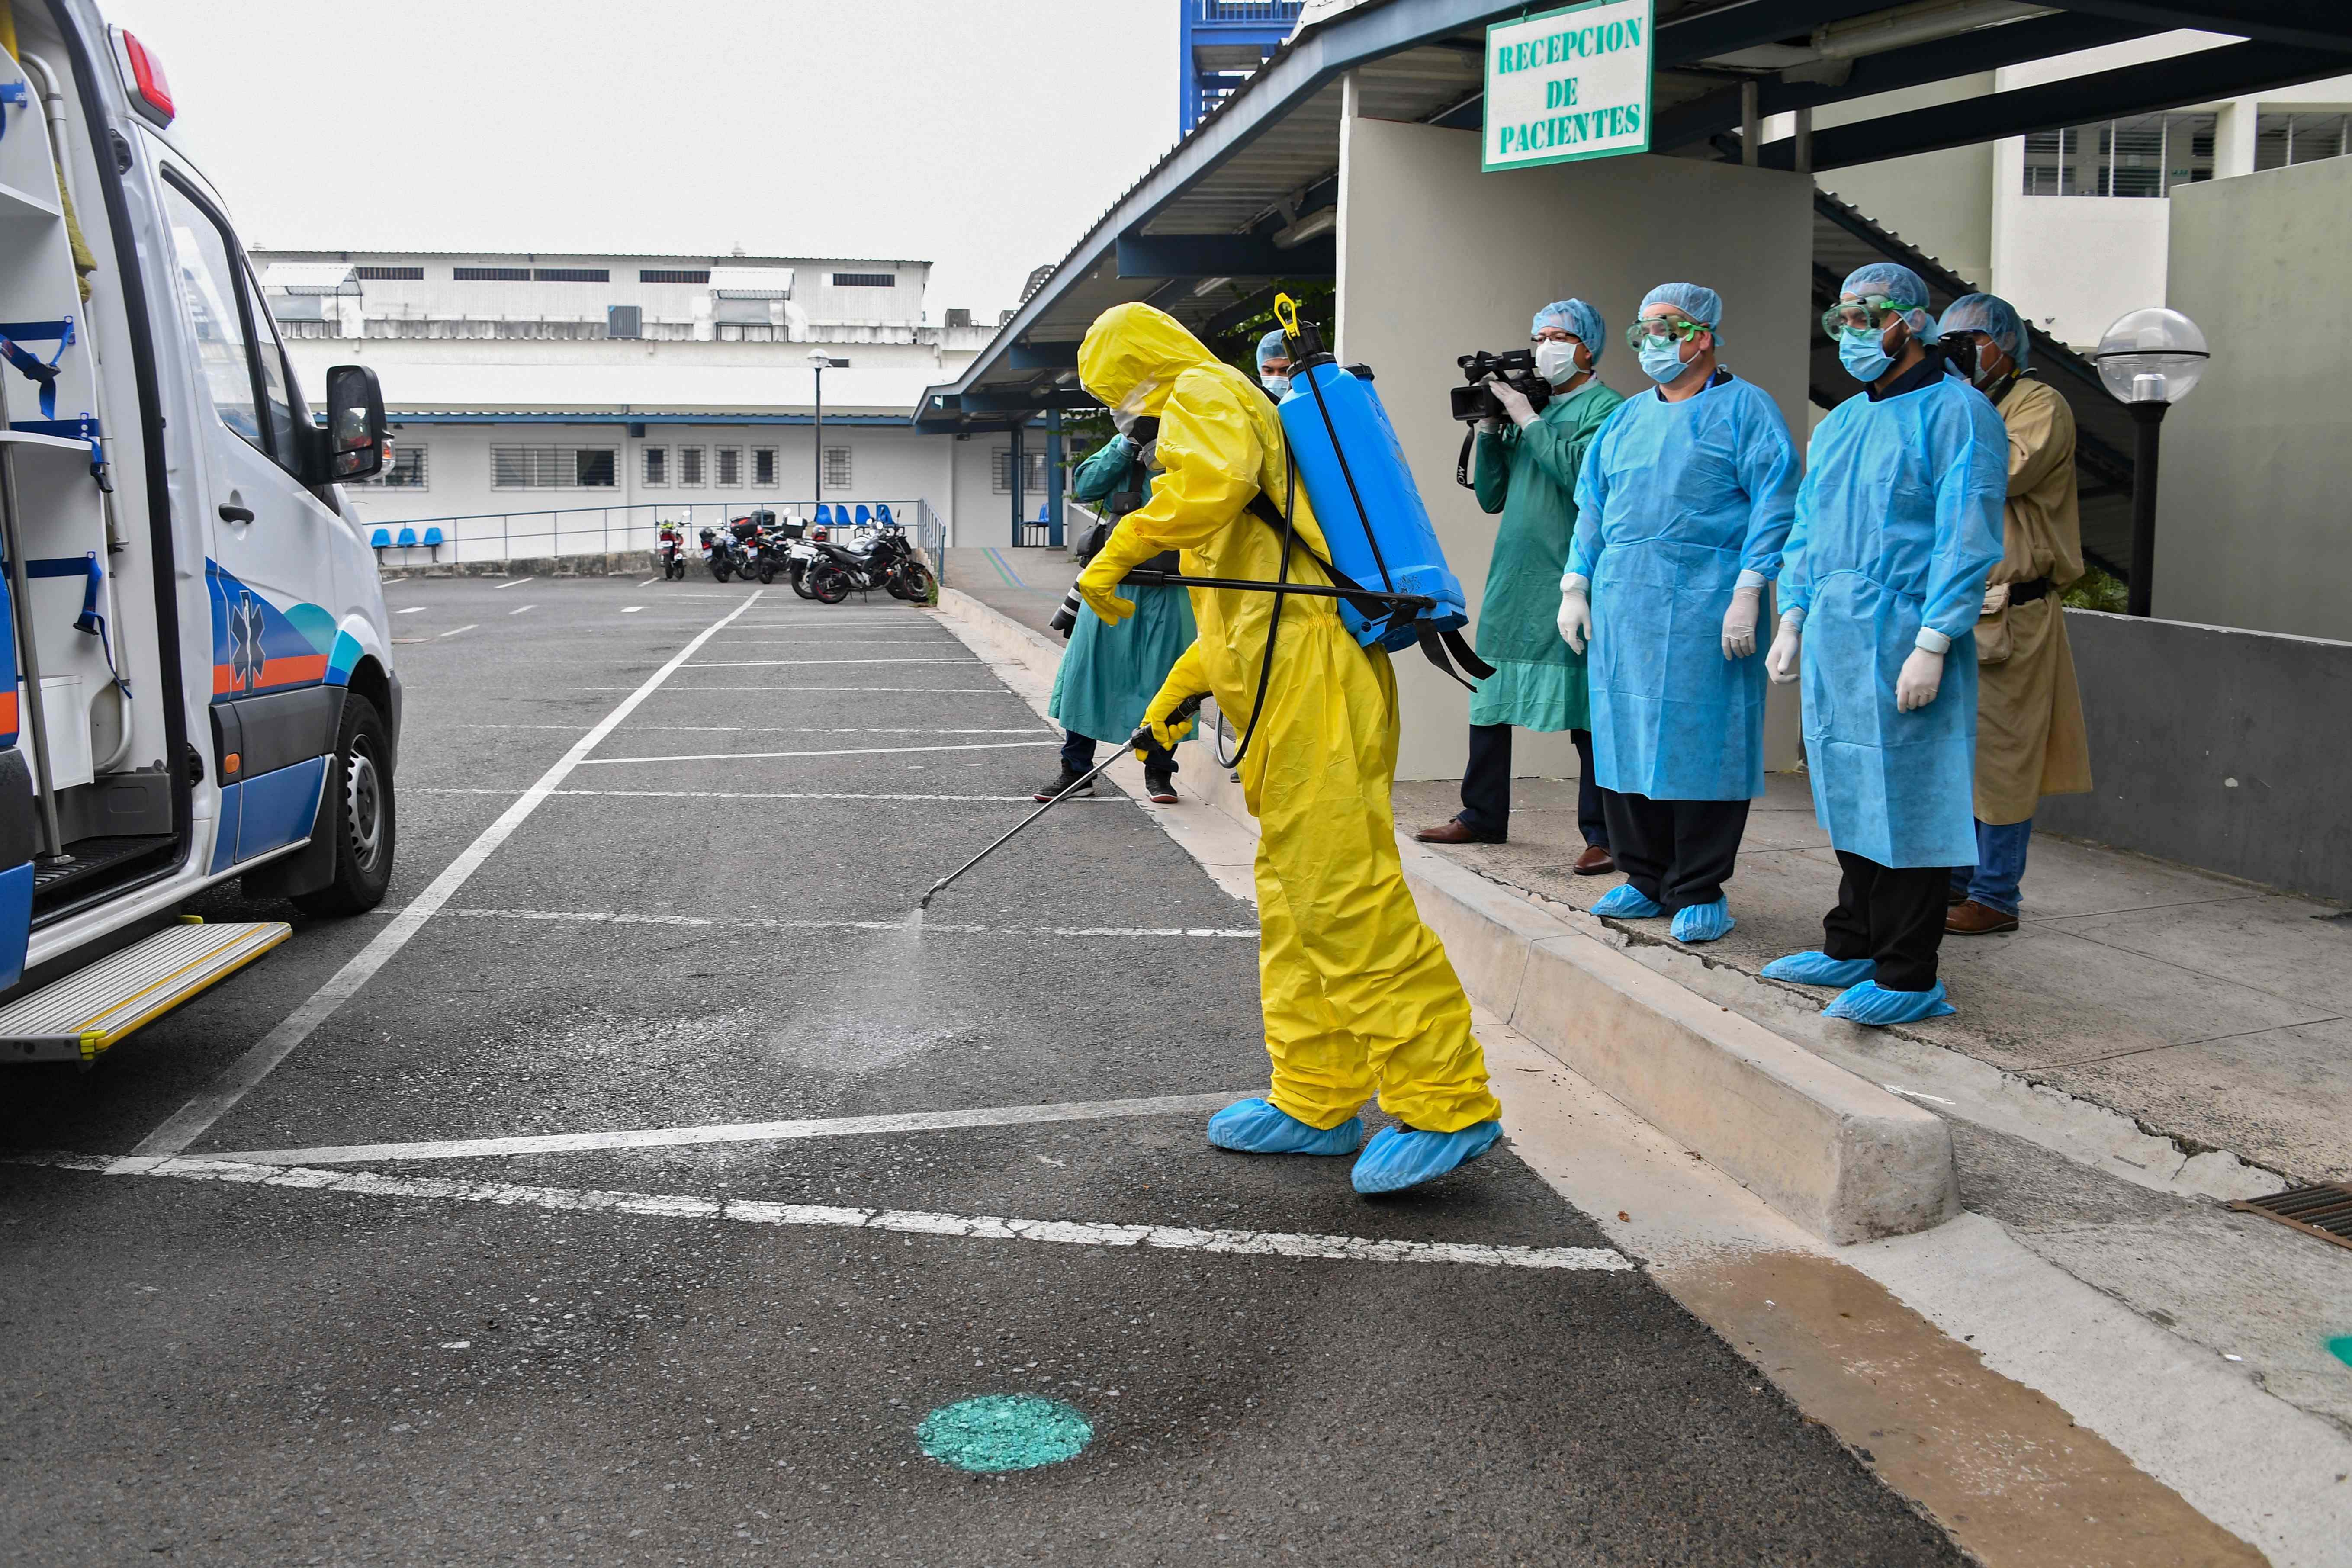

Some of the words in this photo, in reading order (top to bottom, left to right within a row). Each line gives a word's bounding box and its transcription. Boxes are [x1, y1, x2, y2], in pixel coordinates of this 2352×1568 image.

[1498, 16, 1643, 75] RECEPCION
[1546, 77, 1579, 109] DE
[1499, 103, 1642, 155] PACIENTES
